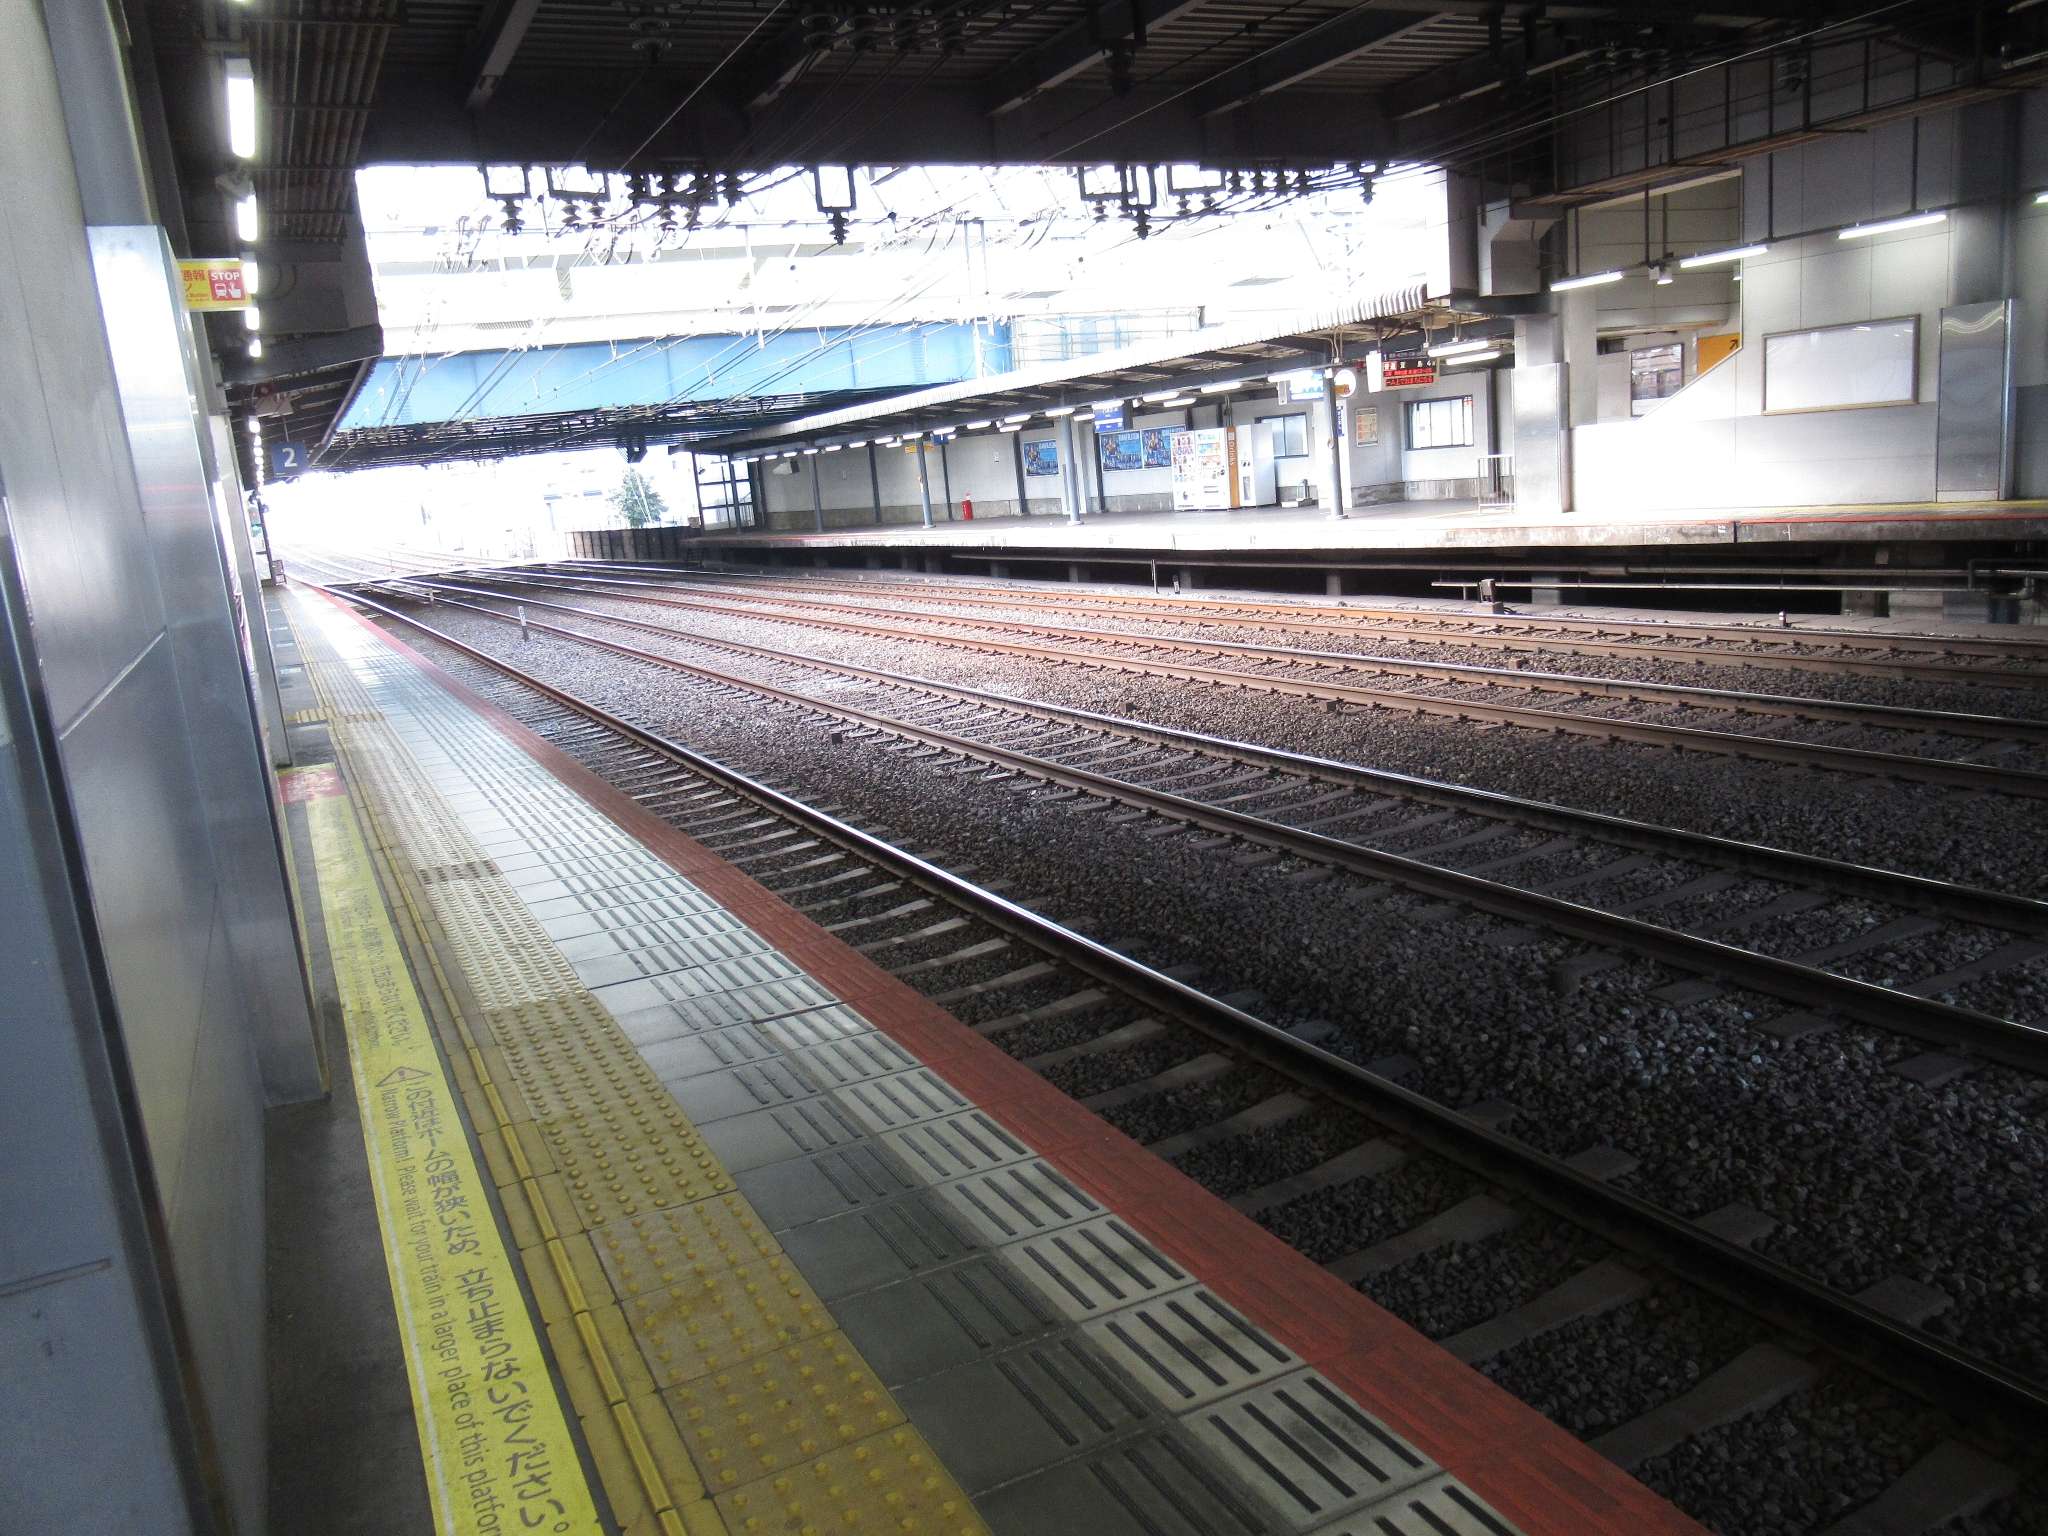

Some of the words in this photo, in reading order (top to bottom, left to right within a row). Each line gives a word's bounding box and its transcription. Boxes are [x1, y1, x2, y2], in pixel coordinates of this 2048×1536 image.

[210, 271, 240, 281] STOP
[282, 447, 298, 467] 2
[382, 1087, 400, 1120] Narrow
[399, 1165, 417, 1197] Please
[405, 1196, 427, 1222] wait
[411, 1220, 428, 1237] for
[408, 1237, 435, 1263] your
[420, 1263, 442, 1295] train
[428, 1293, 450, 1310] in
[431, 1311, 449, 1321] a
[431, 1316, 460, 1362] larger
[438, 1366, 472, 1411] place
[454, 1413, 485, 1431] of
[459, 1432, 491, 1468] this
